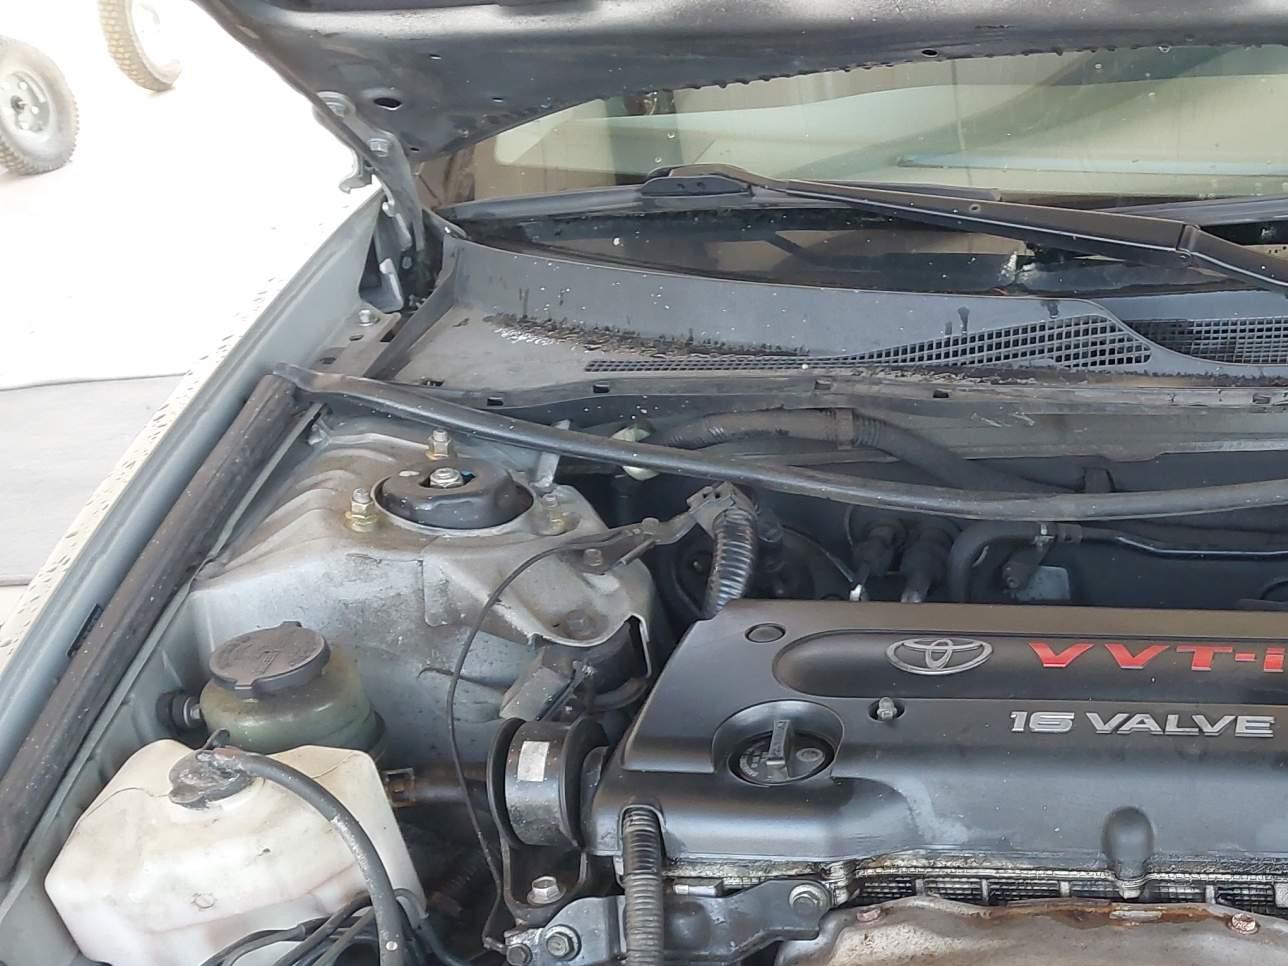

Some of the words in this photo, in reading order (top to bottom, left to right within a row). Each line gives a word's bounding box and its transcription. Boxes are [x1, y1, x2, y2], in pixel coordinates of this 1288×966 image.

[1028, 642, 1287, 673] VVT-i
[1009, 710, 1076, 735] 16
[1085, 712, 1276, 738] VALVE
